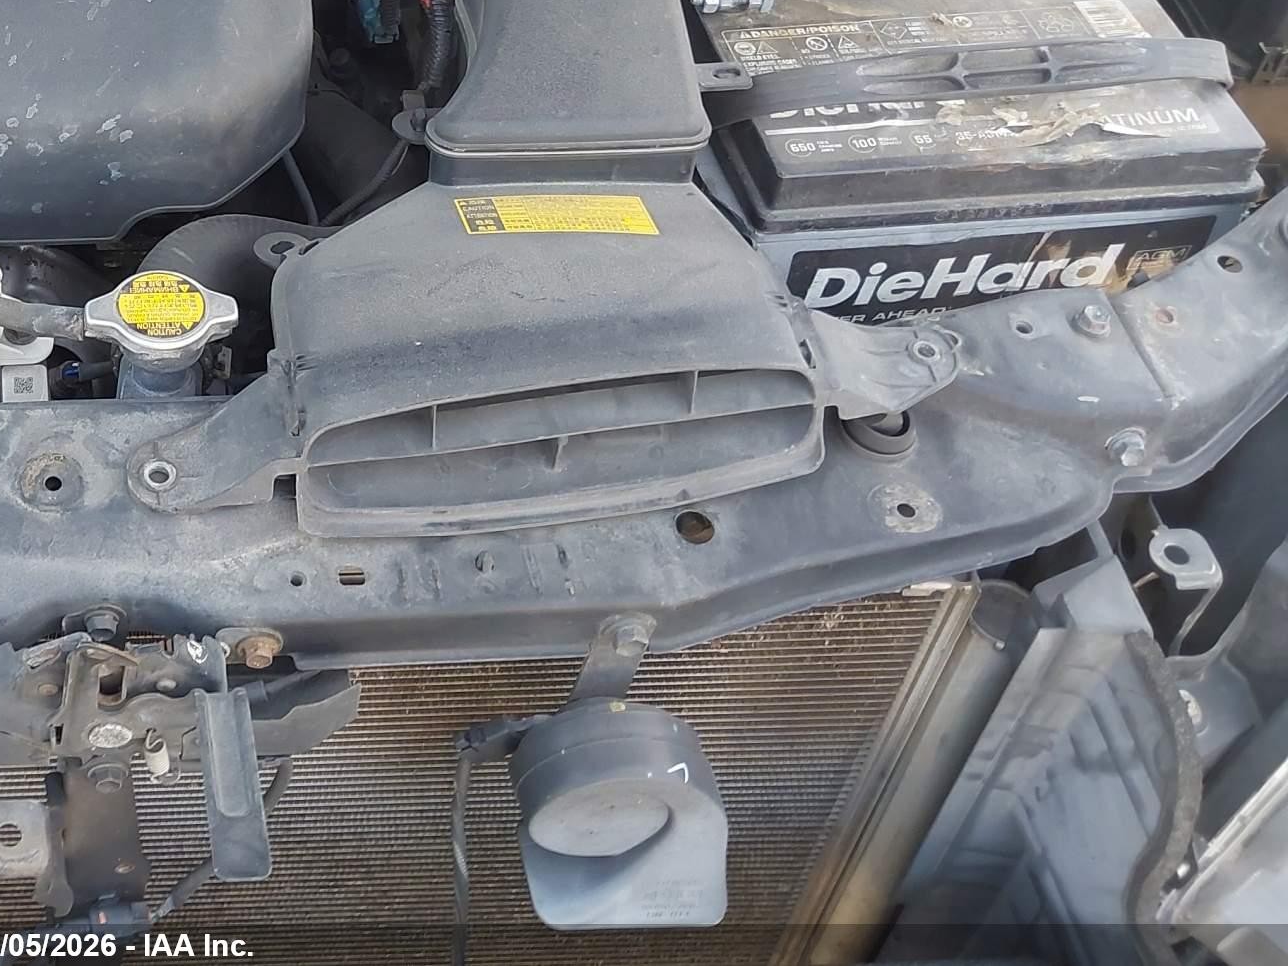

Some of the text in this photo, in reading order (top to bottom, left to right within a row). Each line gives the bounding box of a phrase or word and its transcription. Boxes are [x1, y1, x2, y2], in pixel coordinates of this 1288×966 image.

[750, 24, 860, 39] DANGER/POISON
[851, 137, 877, 149] 100
[913, 133, 933, 144] 55
[790, 141, 816, 153] 650
[804, 243, 1126, 309] DieHard
[147, 328, 182, 336] CAUTION
